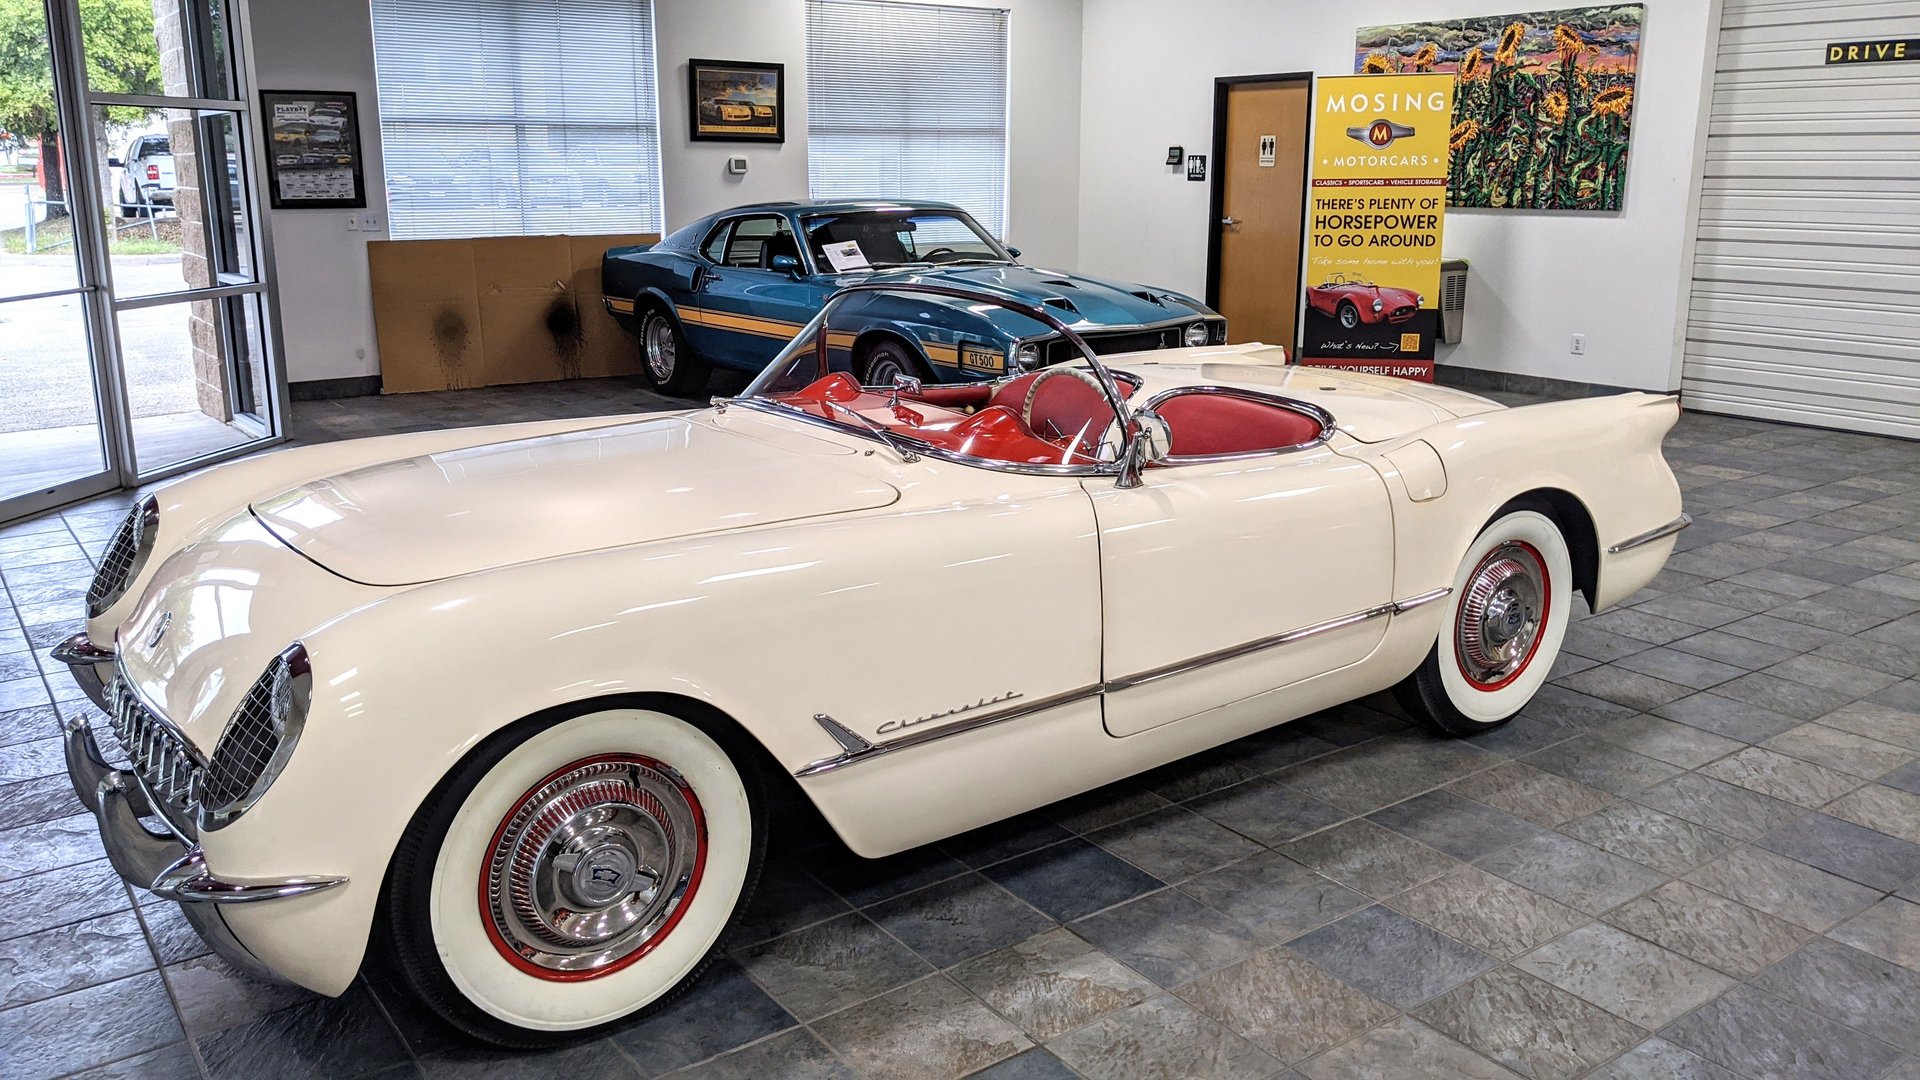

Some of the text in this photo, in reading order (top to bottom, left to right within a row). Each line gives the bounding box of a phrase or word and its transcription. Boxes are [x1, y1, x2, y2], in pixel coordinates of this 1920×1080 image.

[1830, 43, 1906, 61] DRIVE
[1326, 92, 1444, 112] MOSING
[1372, 127, 1388, 140] M
[1333, 155, 1428, 167] MOTORCARS
[1315, 198, 1439, 210] THERE'S PLENTY OF
[1315, 215, 1438, 229] HORSEPOWER
[1314, 235, 1436, 247] TO GO AROUND
[1312, 257, 1332, 265] Take
[1363, 257, 1387, 265] home
[1391, 257, 1414, 265] with
[1415, 257, 1439, 268] you!
[1320, 341, 1379, 350] What's New?
[1392, 366, 1428, 376] HAPPY
